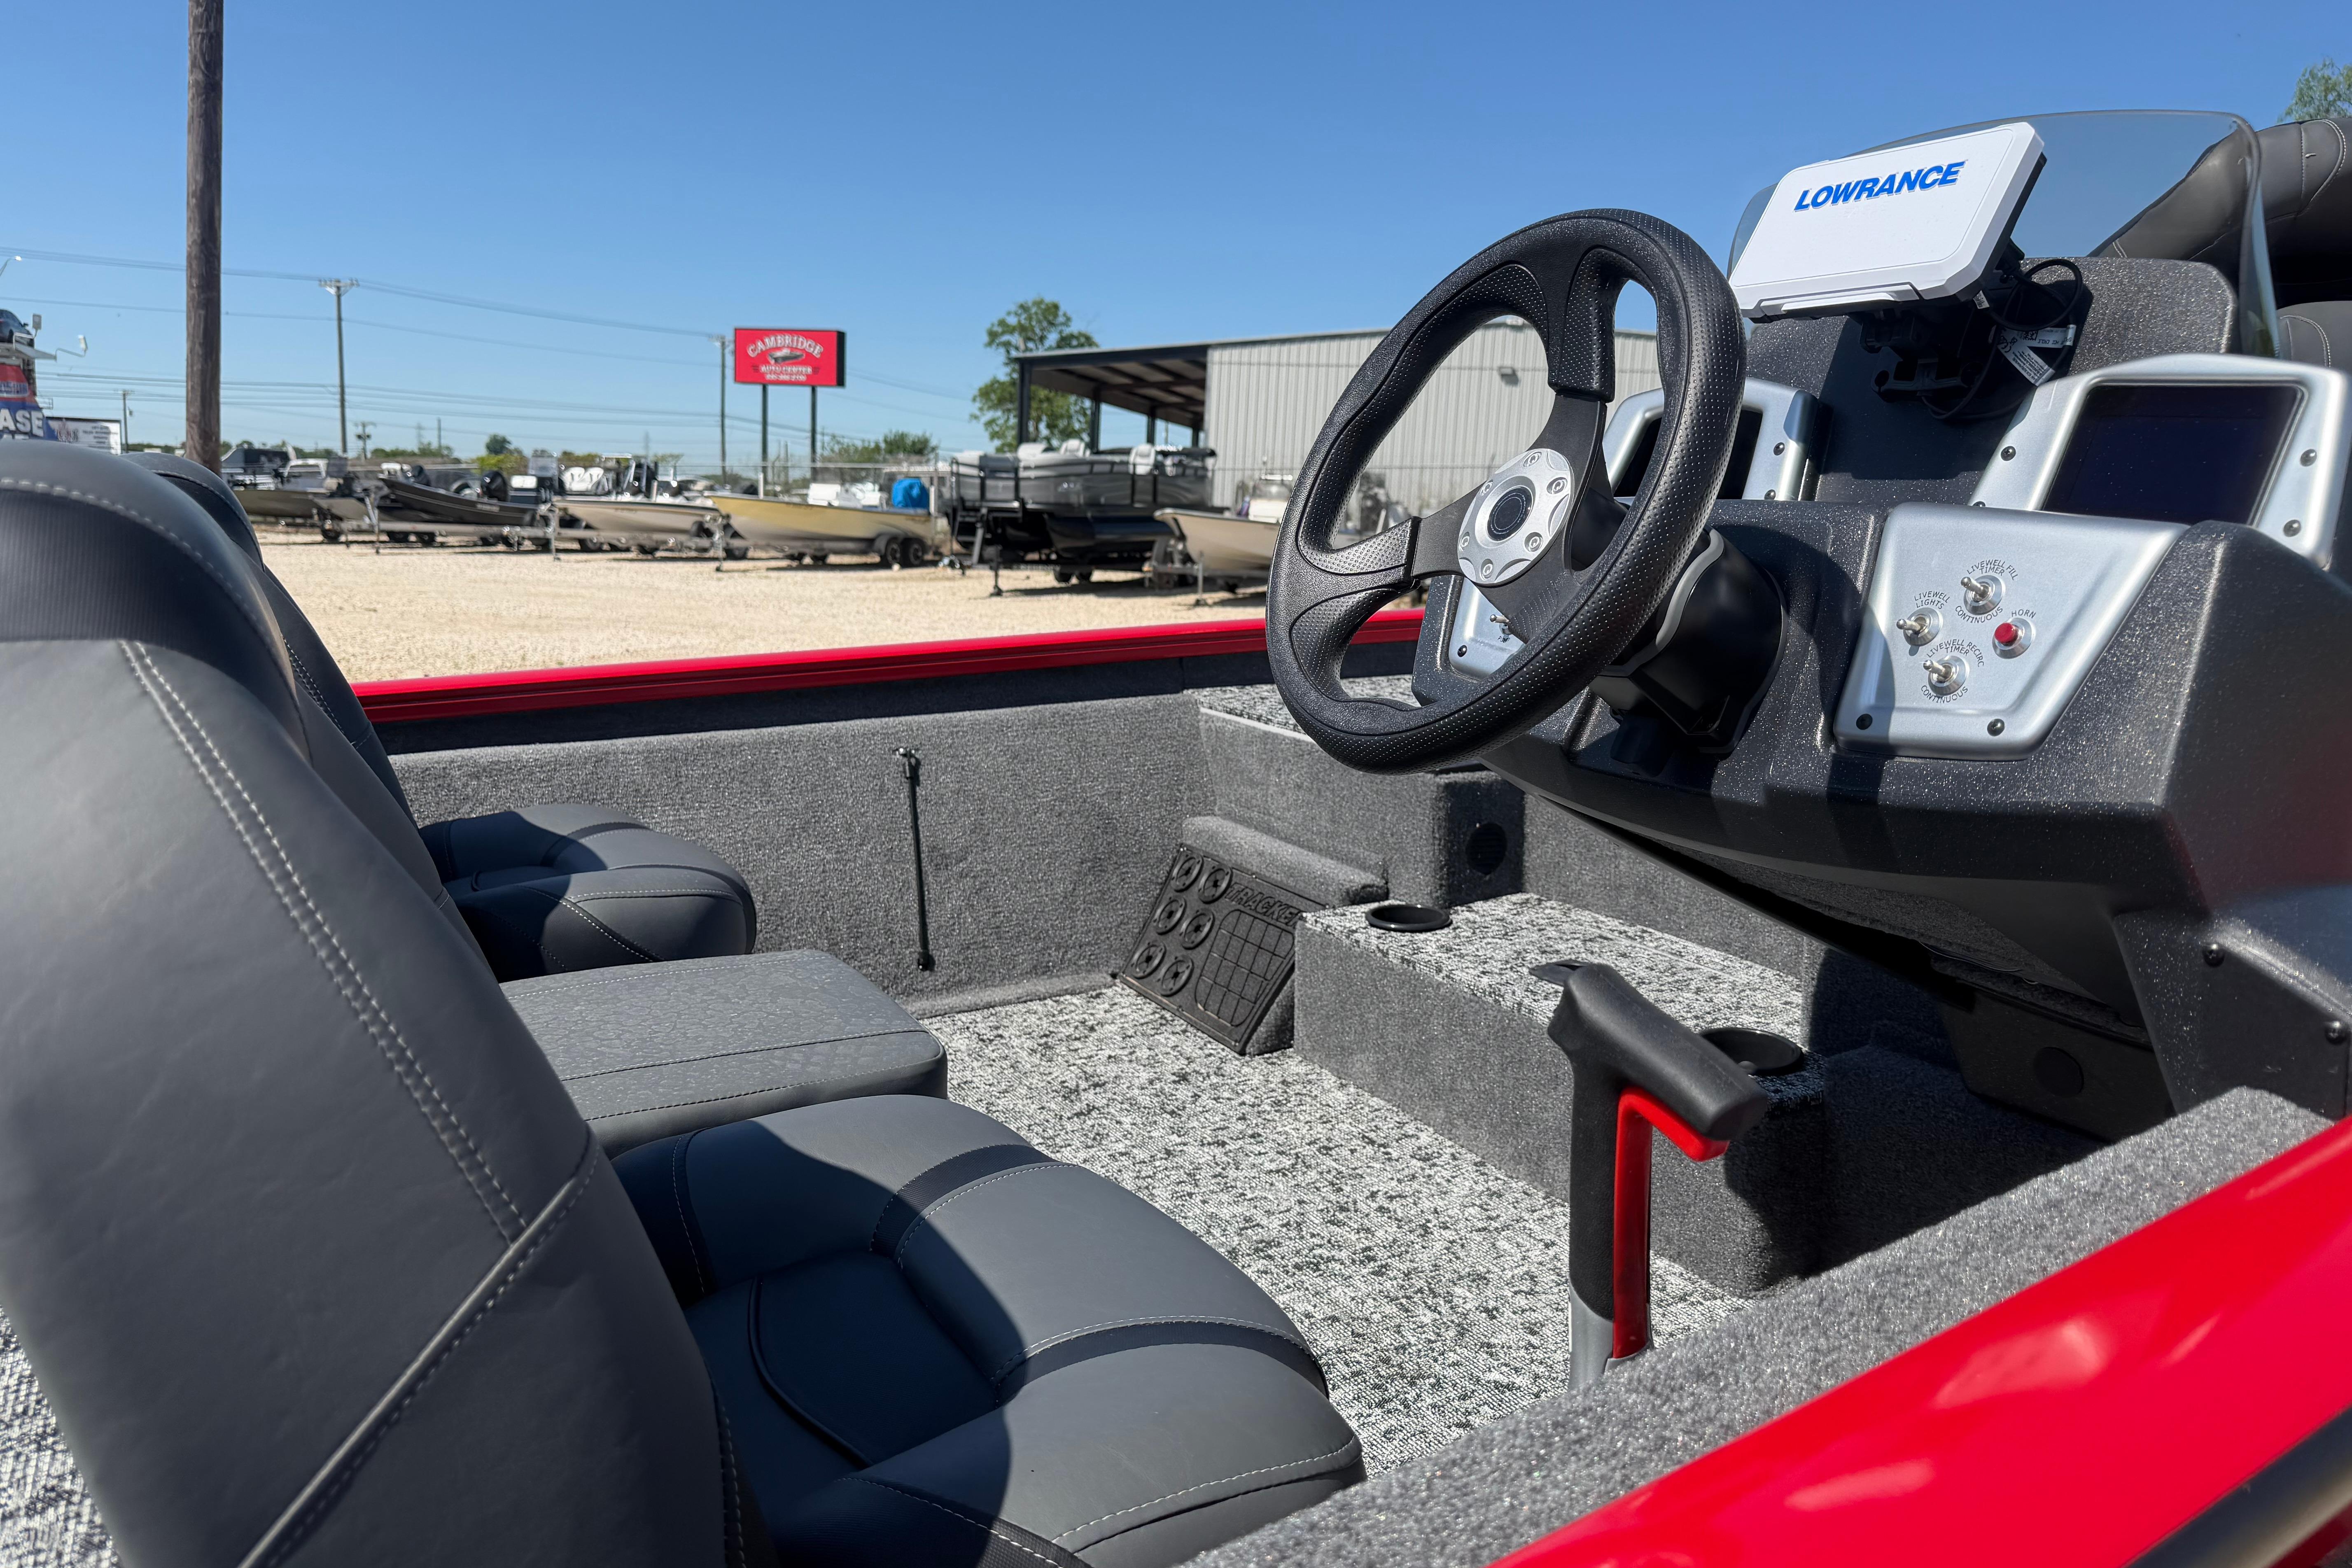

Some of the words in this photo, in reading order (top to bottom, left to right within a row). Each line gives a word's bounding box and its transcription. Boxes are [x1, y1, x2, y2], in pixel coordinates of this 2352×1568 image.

[1794, 161, 1967, 212] LOWRANCE
[747, 334, 824, 358] CAMBRIDGE
[760, 364, 781, 373] AUTO
[782, 365, 812, 375] CENTER
[1967, 559, 2005, 574] LIVEWELL
[2007, 564, 2018, 581] FILL
[1979, 567, 2005, 576] TIMER
[1914, 591, 1950, 603] LIVEWELL
[1916, 599, 1944, 610] LIGHTS
[1955, 605, 2003, 623] CONTINUOUS
[2011, 609, 2036, 619] HORN
[1927, 639, 1965, 658] LIVEWELL
[1966, 642, 1984, 667] RECIRC
[1945, 647, 1969, 656] TIMER
[1921, 685, 1968, 704] CONTINUOUS
